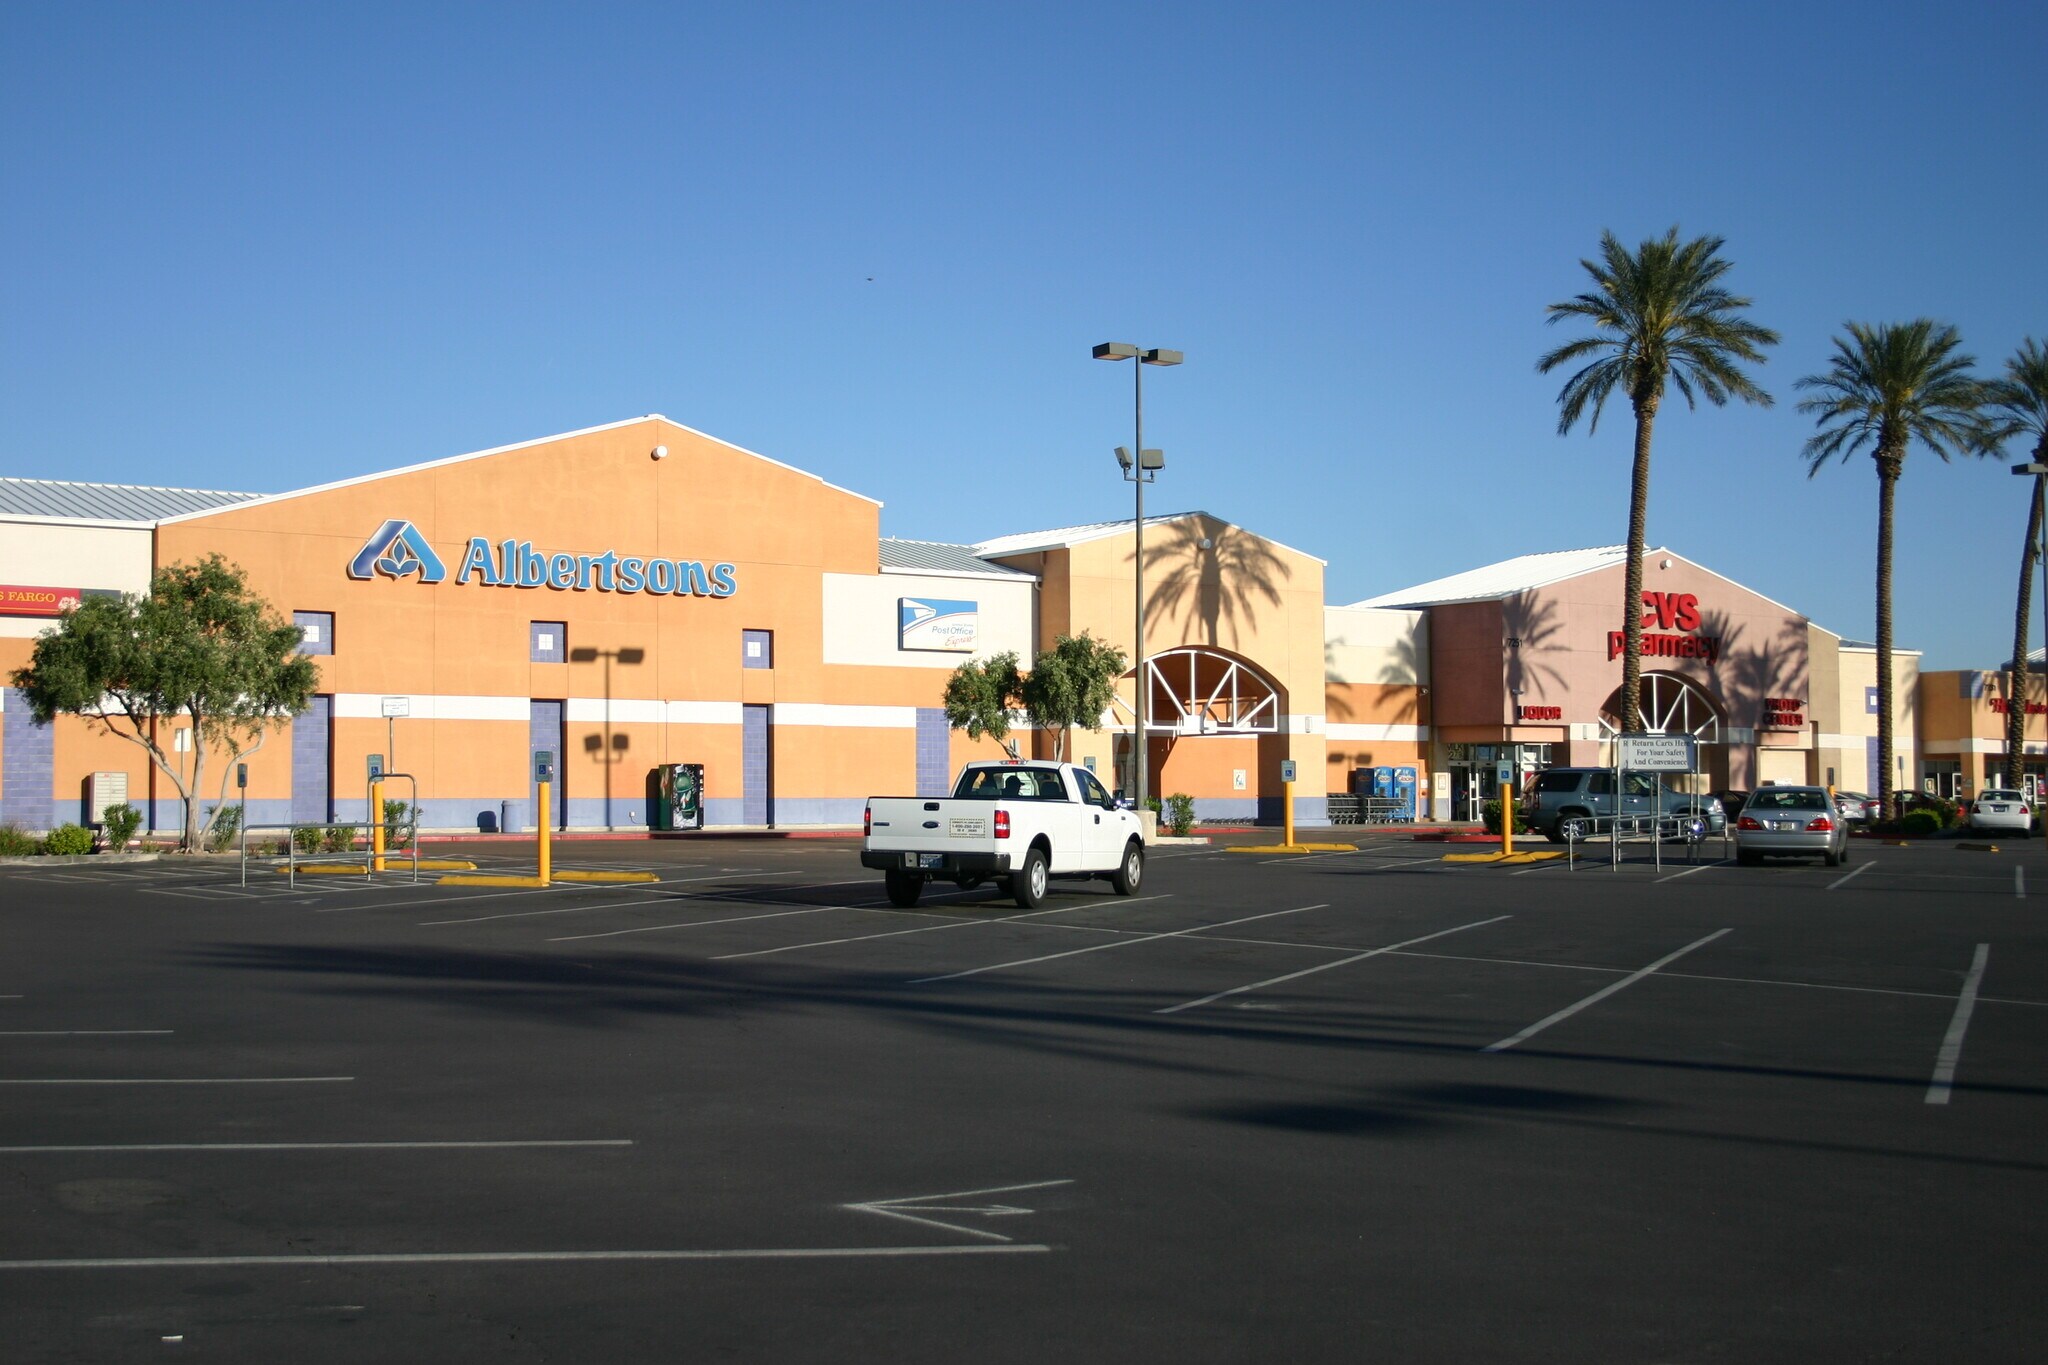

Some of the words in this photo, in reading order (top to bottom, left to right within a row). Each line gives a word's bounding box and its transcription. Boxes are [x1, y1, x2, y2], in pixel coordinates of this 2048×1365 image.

[456, 536, 738, 597] Albertsons
[8, 591, 56, 603] FARGO
[1639, 590, 1702, 632] CVS
[932, 626, 949, 635] Post
[950, 626, 974, 636] Office
[1607, 631, 1721, 666] parmacy
[1764, 698, 1801, 712] PHOTO
[1517, 706, 1561, 720] LIQUOR
[1762, 712, 1803, 726] CENTER
[1665, 749, 1685, 758] Safety
[1648, 758, 1687, 766] Convenience
